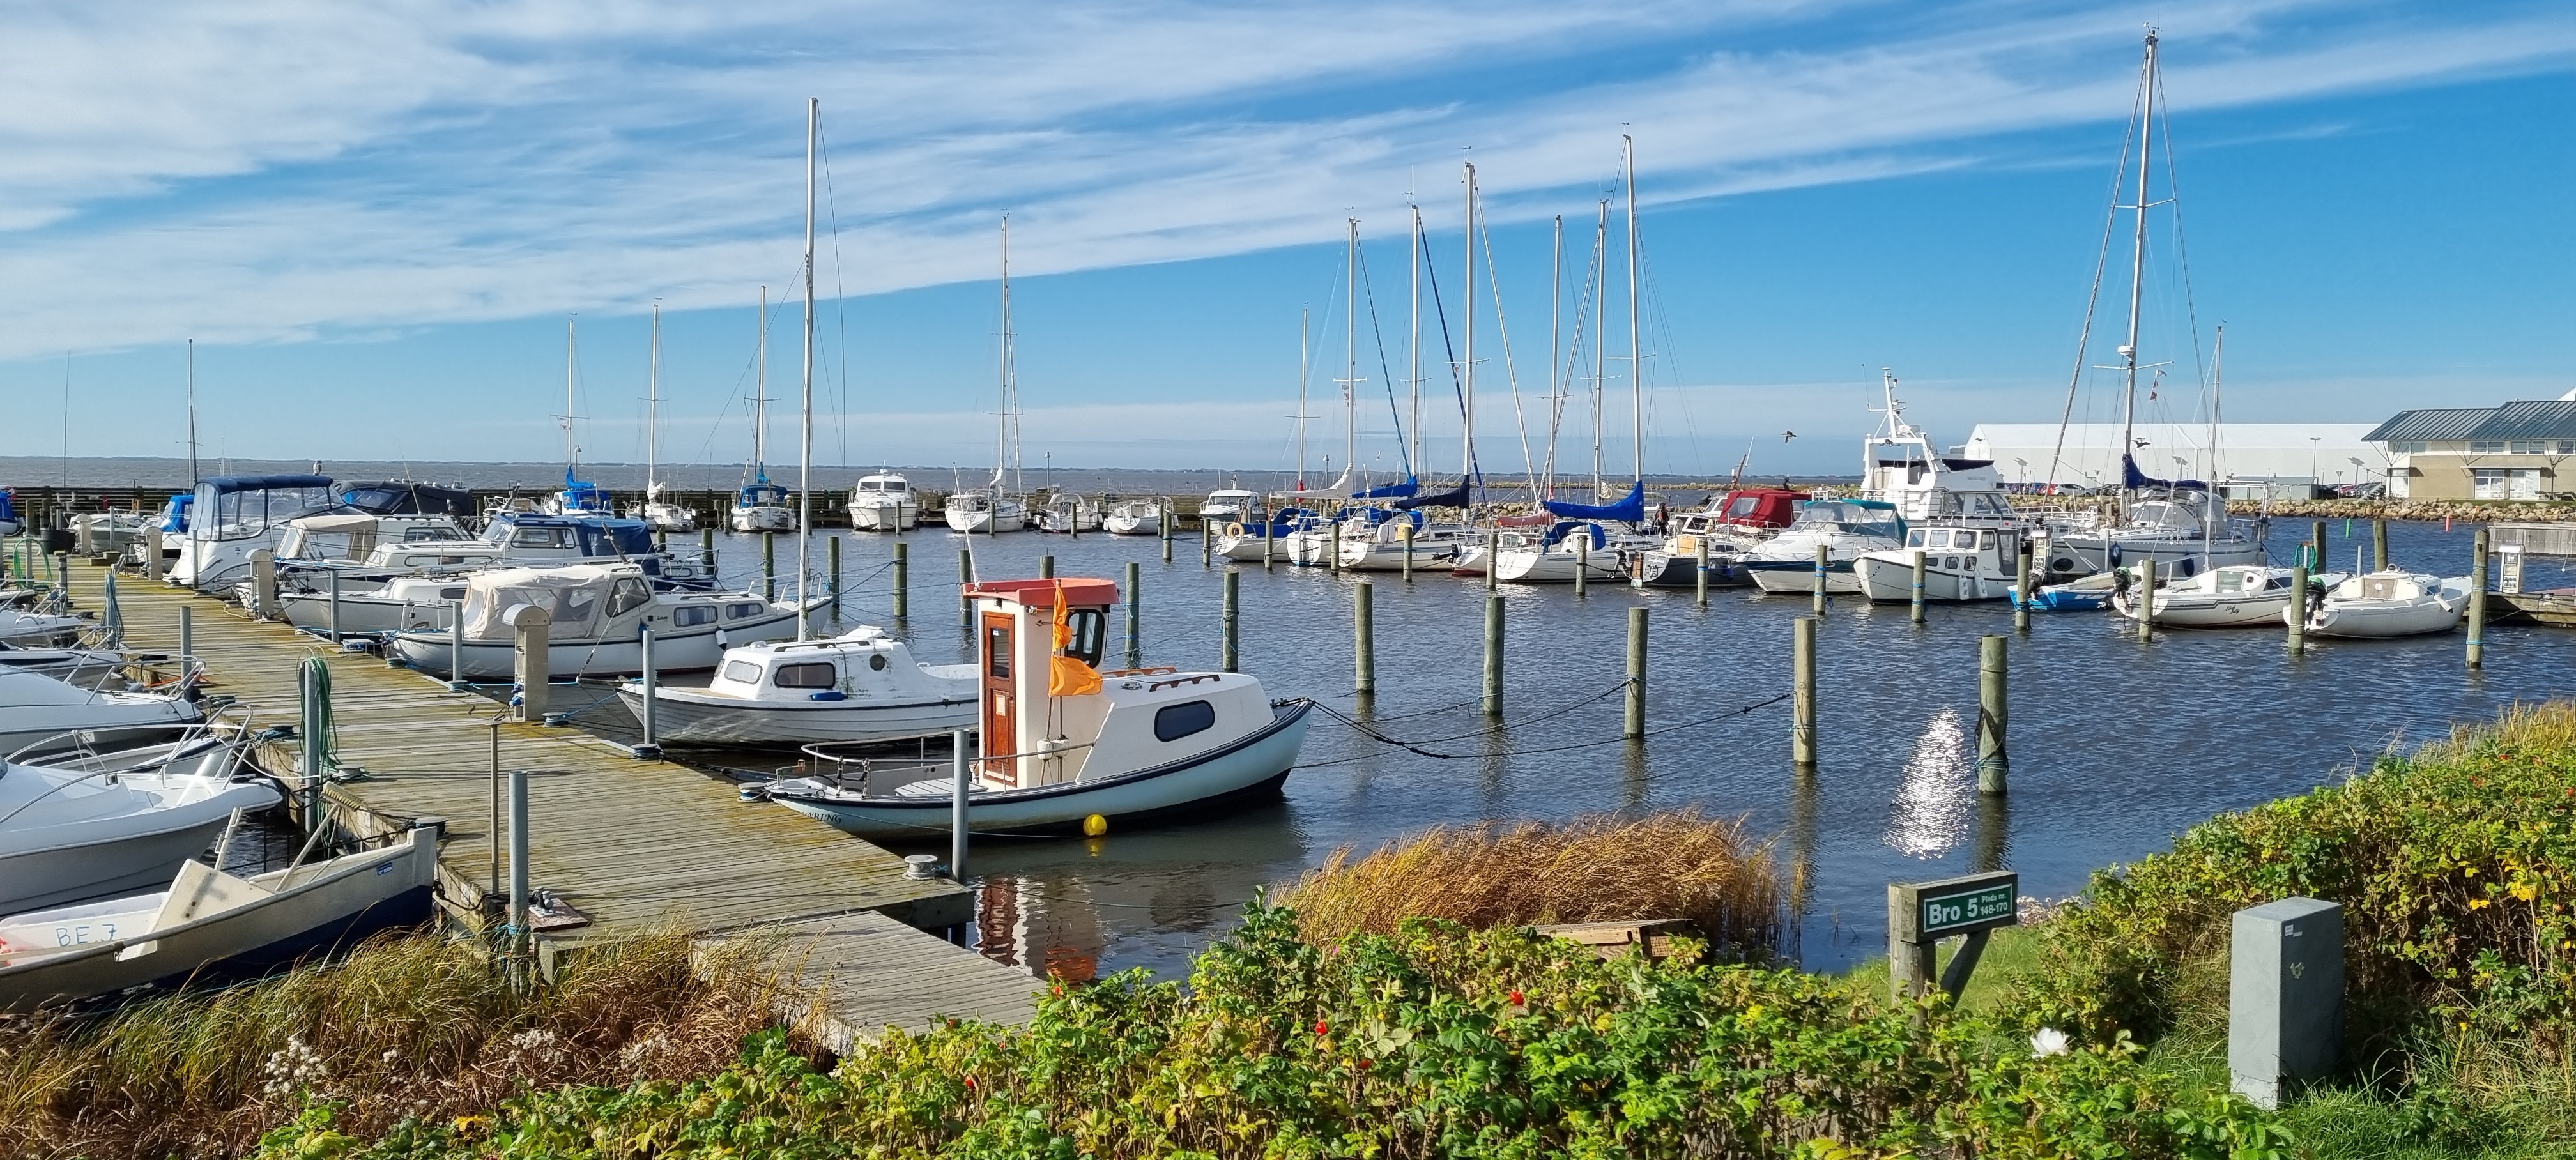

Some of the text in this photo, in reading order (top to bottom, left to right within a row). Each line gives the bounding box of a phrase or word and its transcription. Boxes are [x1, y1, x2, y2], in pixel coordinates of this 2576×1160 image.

[1981, 894, 1997, 903] Plads
[1929, 897, 1978, 925] Bro 5
[1981, 902, 2007, 915] 148-170
